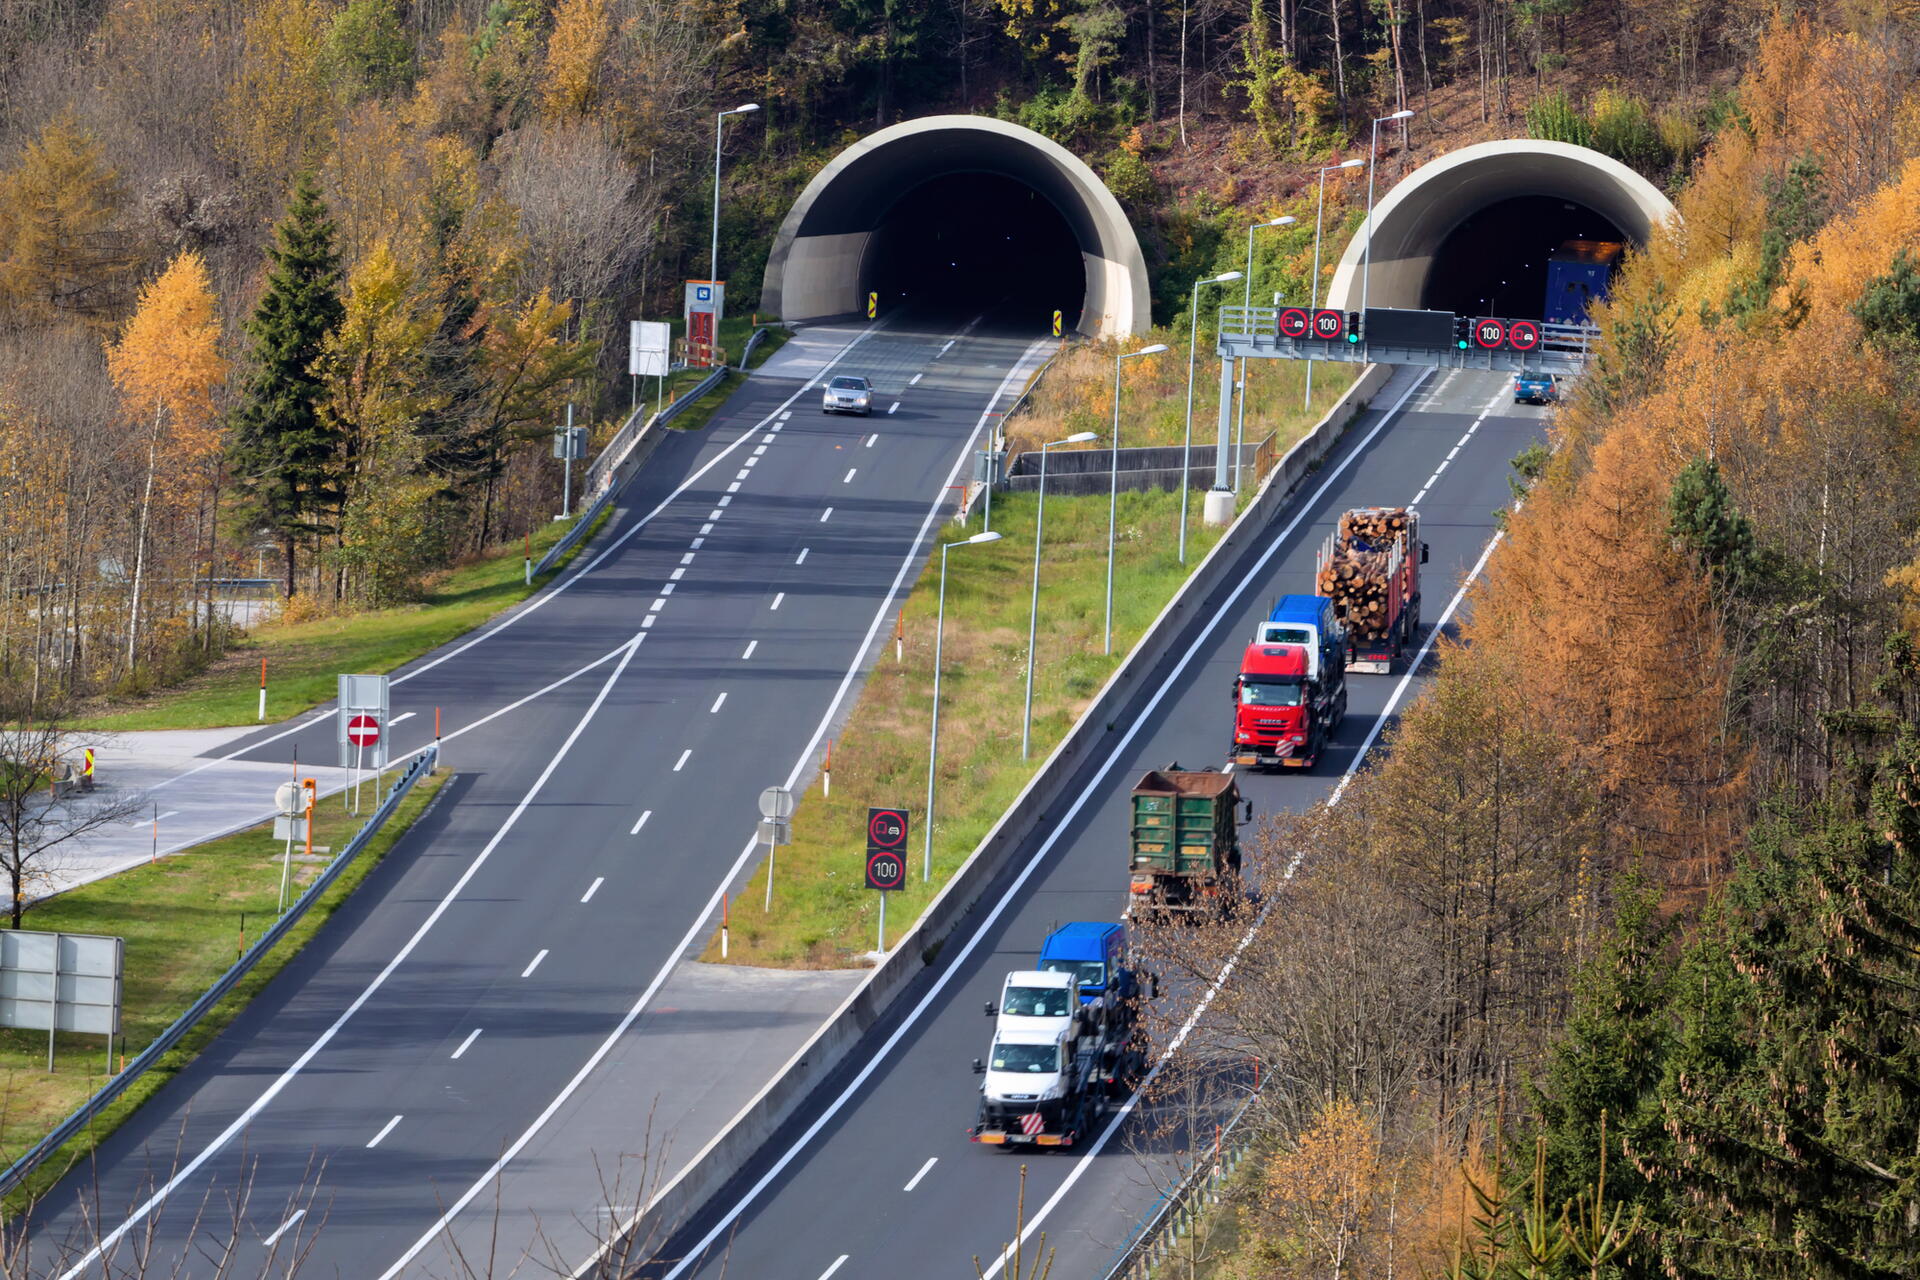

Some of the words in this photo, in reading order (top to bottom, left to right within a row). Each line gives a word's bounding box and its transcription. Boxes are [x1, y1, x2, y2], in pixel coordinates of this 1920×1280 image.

[1318, 318, 1337, 330] 100
[1481, 327, 1500, 340] 100
[874, 863, 897, 878] 100
